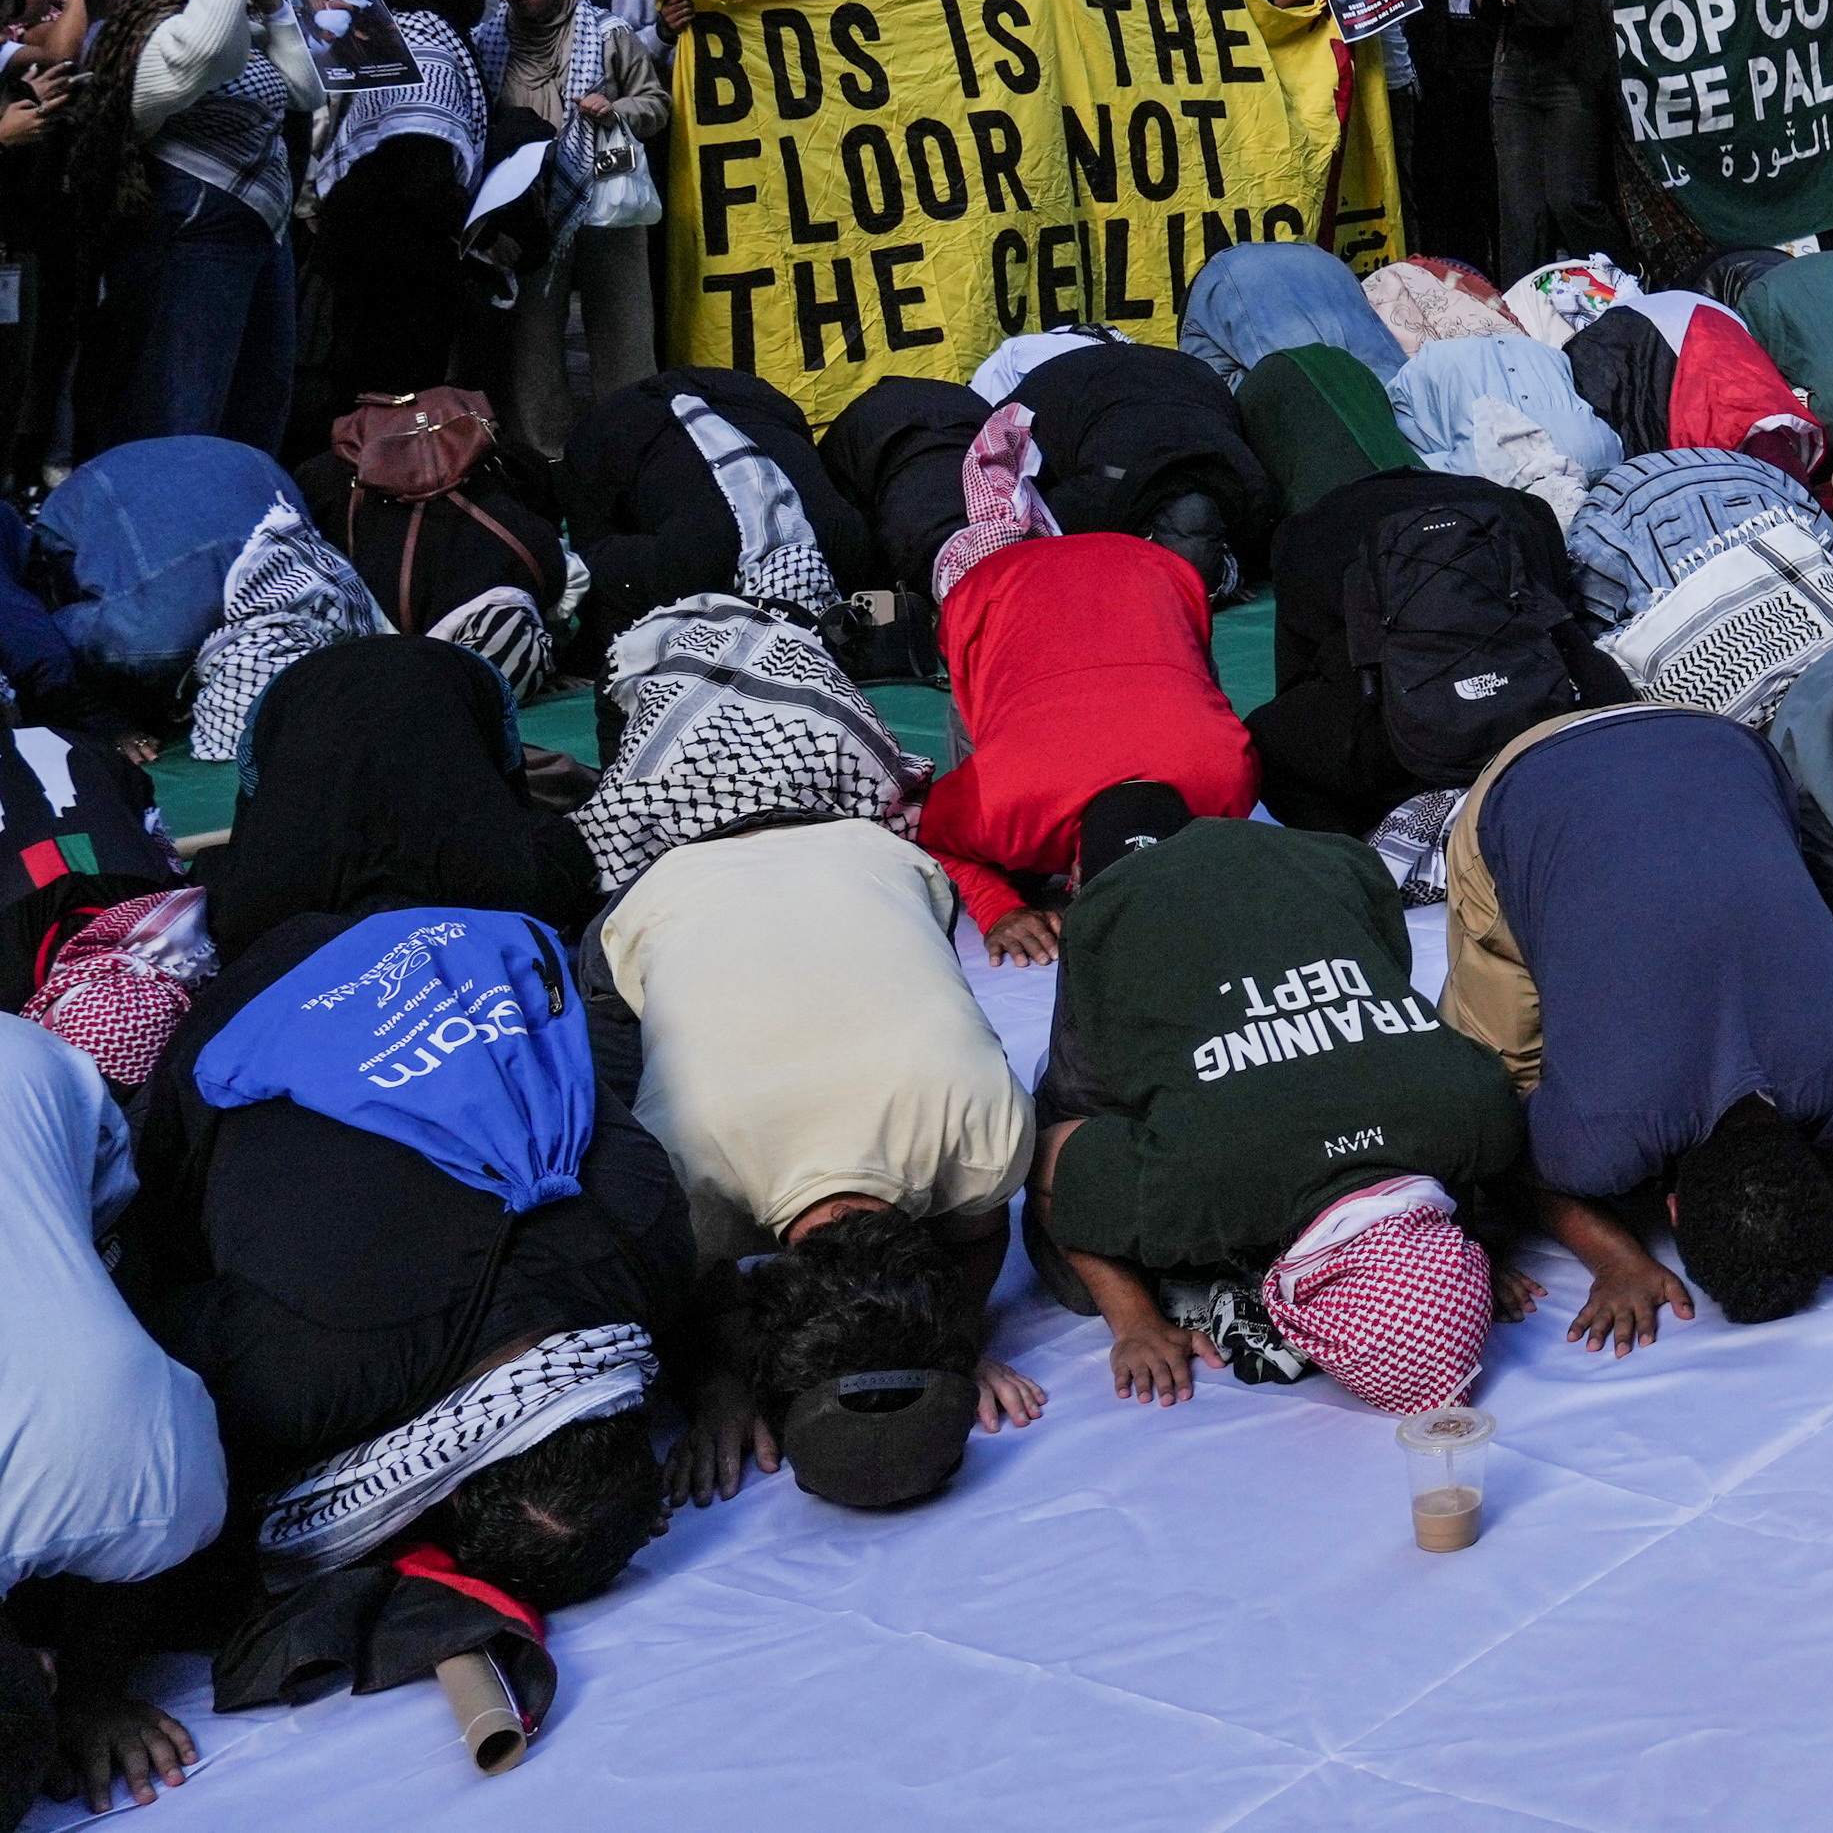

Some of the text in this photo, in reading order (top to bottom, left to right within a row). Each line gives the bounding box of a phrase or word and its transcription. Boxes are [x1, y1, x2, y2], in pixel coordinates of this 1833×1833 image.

[694, 3, 889, 126] BDS
[700, 99, 1228, 257] FLOOR NOT
[702, 244, 945, 375] THE
[1467, 671, 1497, 685] FACE
[1474, 676, 1509, 692] NORTH
[1476, 687, 1497, 698] THE
[1219, 958, 1370, 1018] DEPT.
[358, 1019, 430, 1073] Mentorship
[373, 1010, 405, 1037] with
[1192, 996, 1439, 1082] TRAINING
